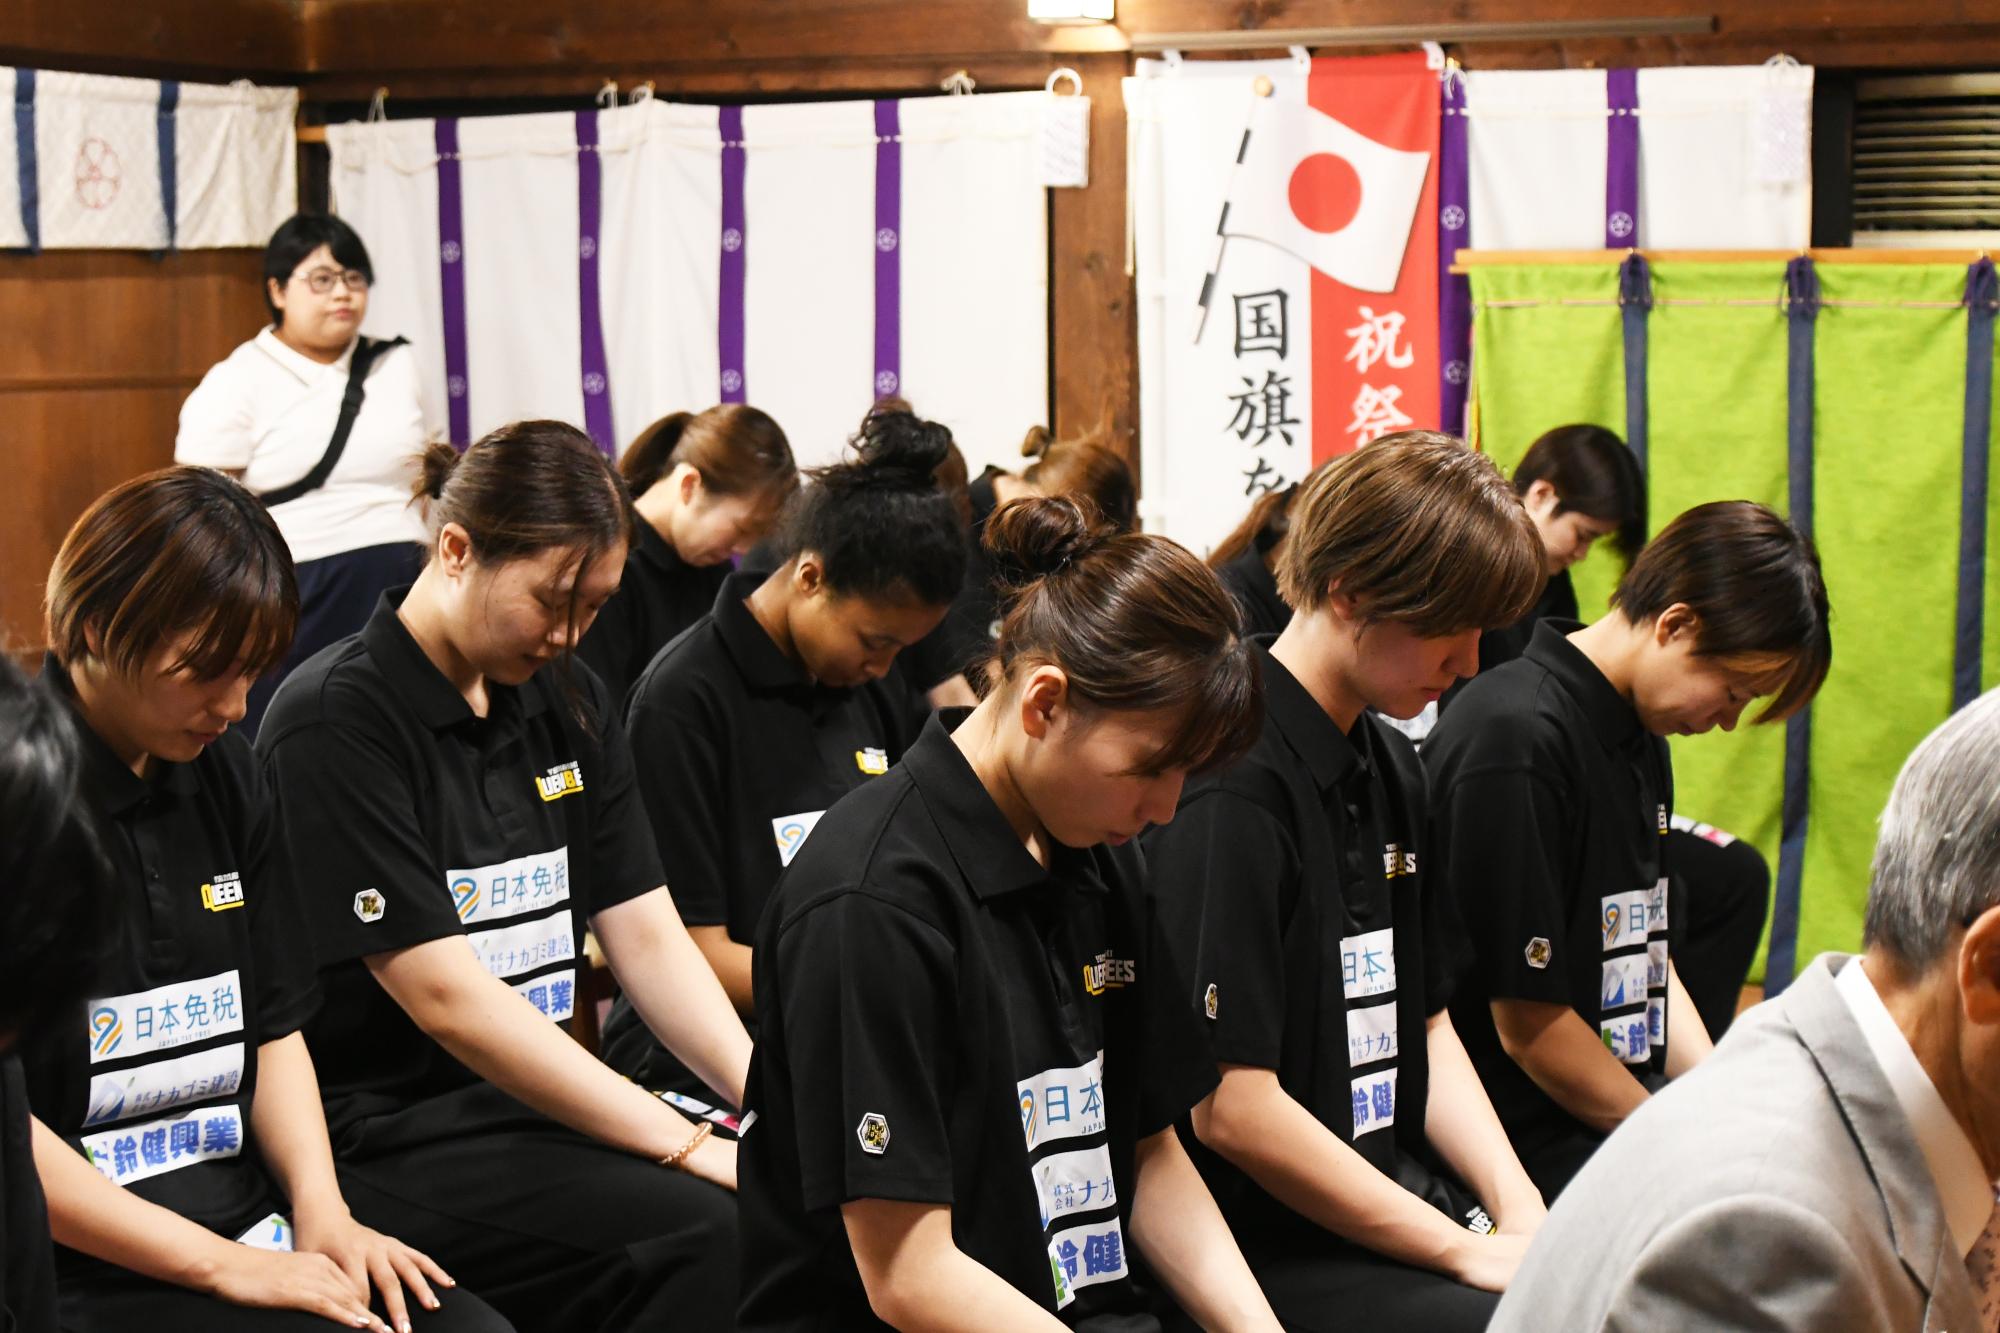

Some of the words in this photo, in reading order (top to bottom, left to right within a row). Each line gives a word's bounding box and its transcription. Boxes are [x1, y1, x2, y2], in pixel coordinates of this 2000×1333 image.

[1224, 289, 1300, 496] 国旗を
[1345, 306, 1414, 448] 祝祭
[491, 859, 566, 907] 日本免税
[1343, 947, 1396, 983] 日本
[136, 984, 238, 1041] 日本免税
[521, 980, 572, 1015] 興業
[1364, 1030, 1398, 1057] ナカ
